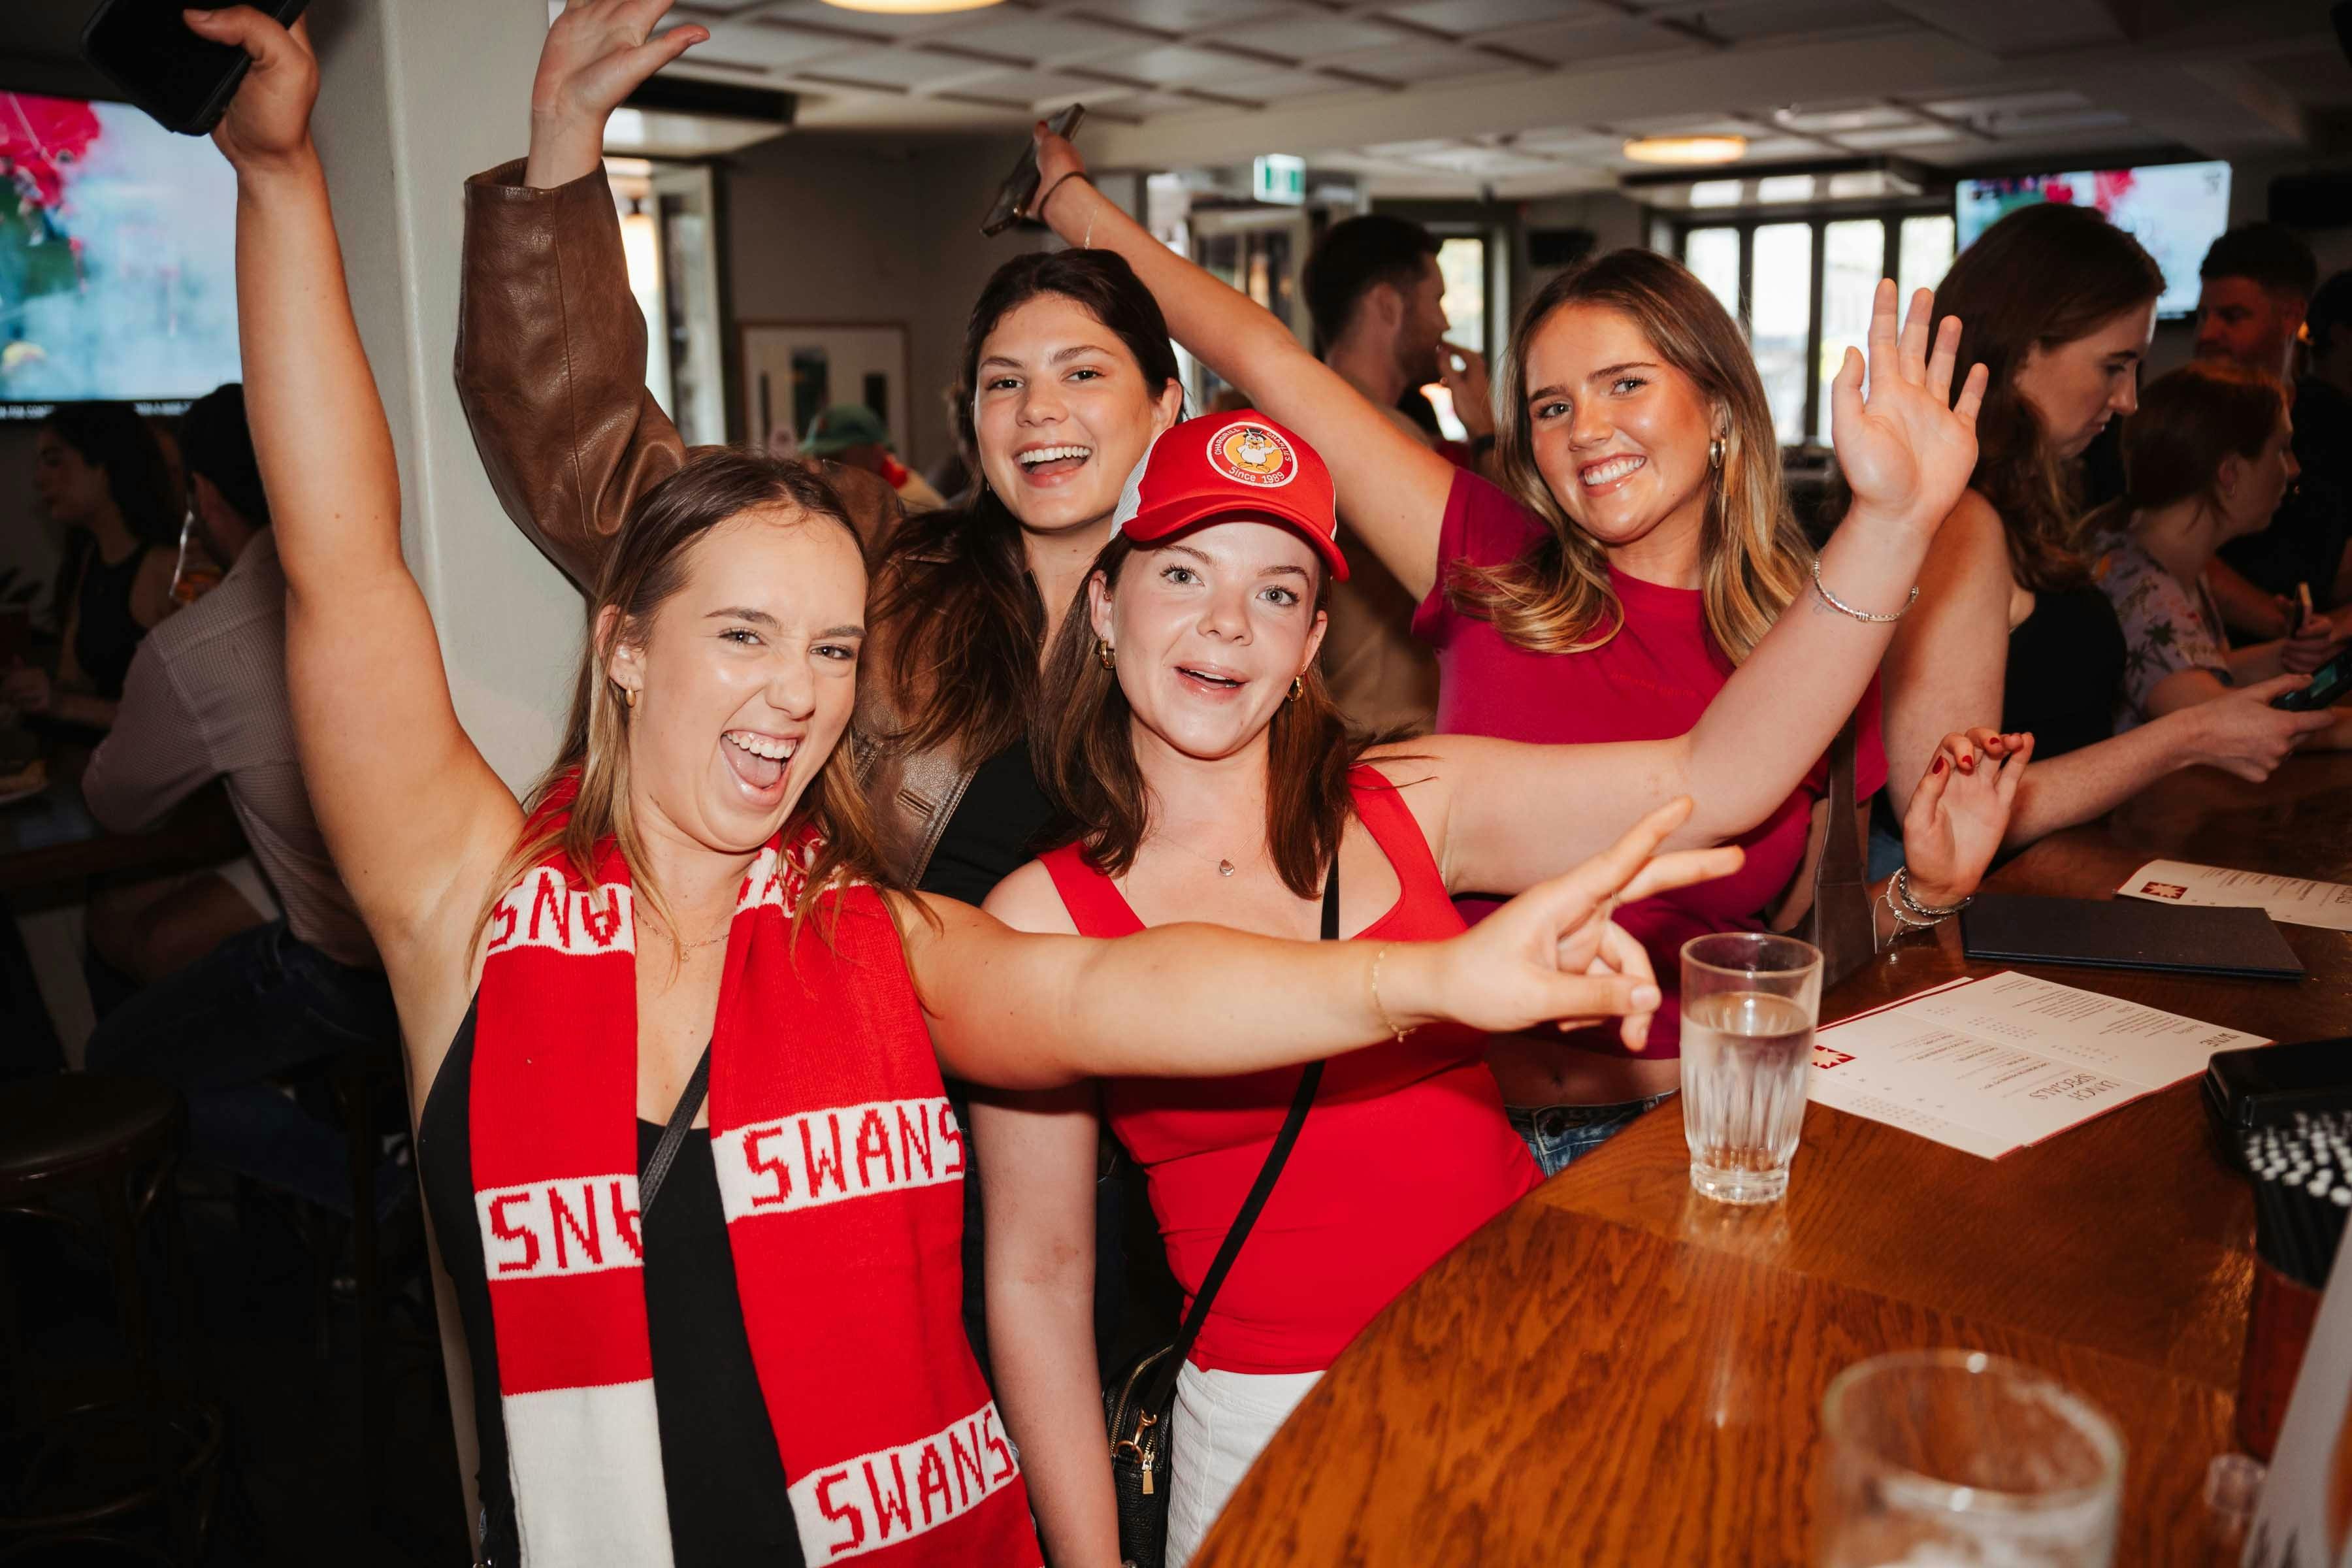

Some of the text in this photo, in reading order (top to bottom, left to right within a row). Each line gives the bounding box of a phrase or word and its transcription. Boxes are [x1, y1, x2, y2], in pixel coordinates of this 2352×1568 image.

[1215, 428, 1292, 463] CHARGRILL CHARLIES
[1229, 466, 1285, 484] Since 1989
[2199, 1032, 2240, 1047] WINE
[2029, 1073, 2096, 1100] SPECIALS
[2068, 1079, 2121, 1101] LUNCH
[742, 1102, 965, 1207] SWANS
[815, 1408, 1015, 1557] SWANS
